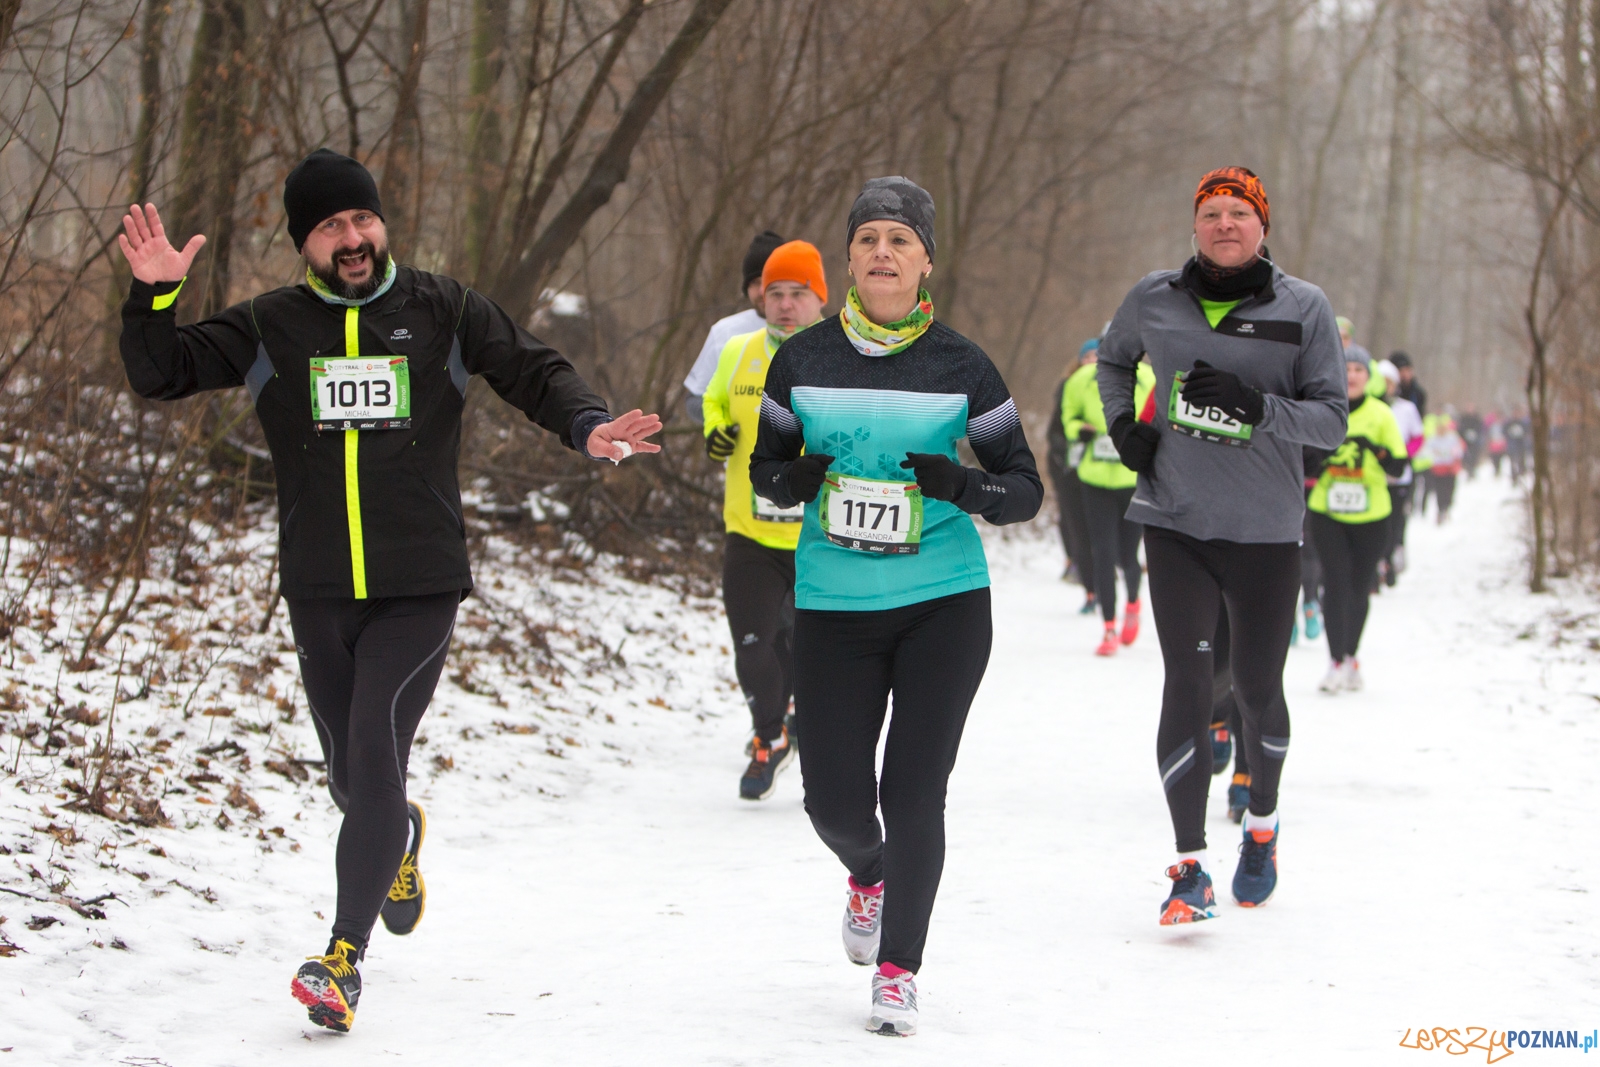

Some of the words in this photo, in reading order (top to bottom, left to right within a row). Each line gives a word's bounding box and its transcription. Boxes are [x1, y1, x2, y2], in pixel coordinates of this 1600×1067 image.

[326, 379, 391, 408] 1013
[344, 410, 372, 418] MICHAŁ
[842, 499, 900, 532] 1171
[844, 529, 893, 542] ALEKSANDRA
